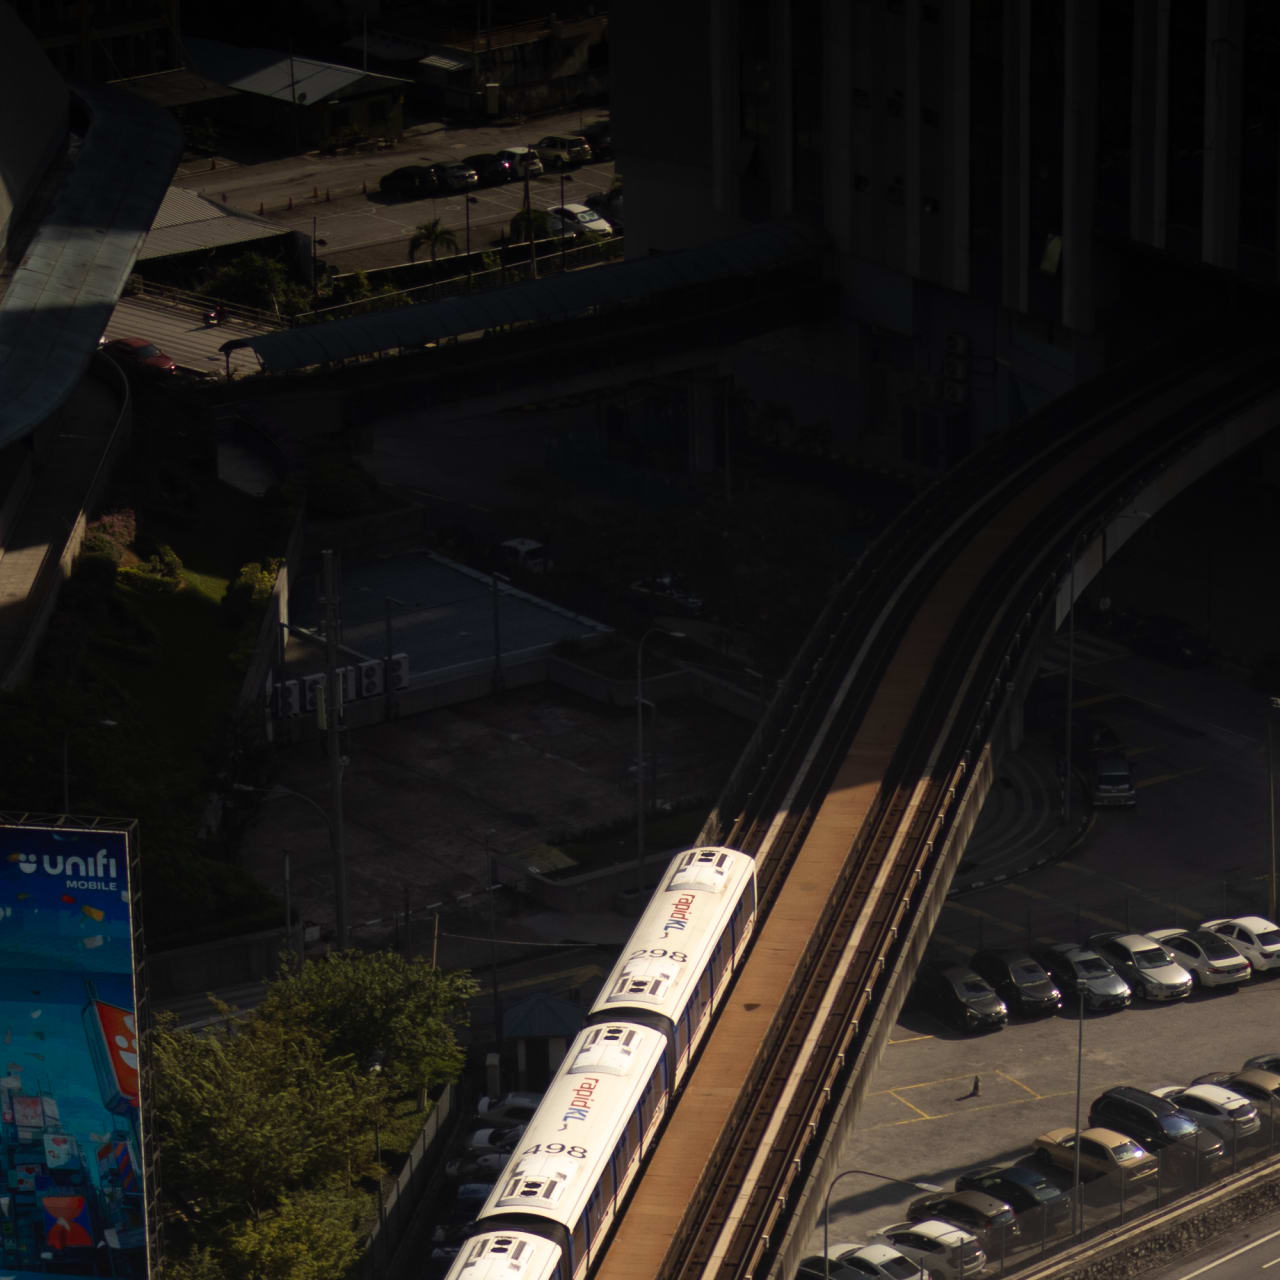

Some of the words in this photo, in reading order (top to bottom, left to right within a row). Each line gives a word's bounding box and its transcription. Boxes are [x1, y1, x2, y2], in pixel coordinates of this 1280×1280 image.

[42, 848, 118, 879] unifi
[66, 879, 119, 892] MOBILE
[663, 893, 696, 932] rapidKL
[628, 948, 689, 963] 298
[562, 1077, 600, 1122] rapidKL
[522, 1143, 588, 1160] 498
